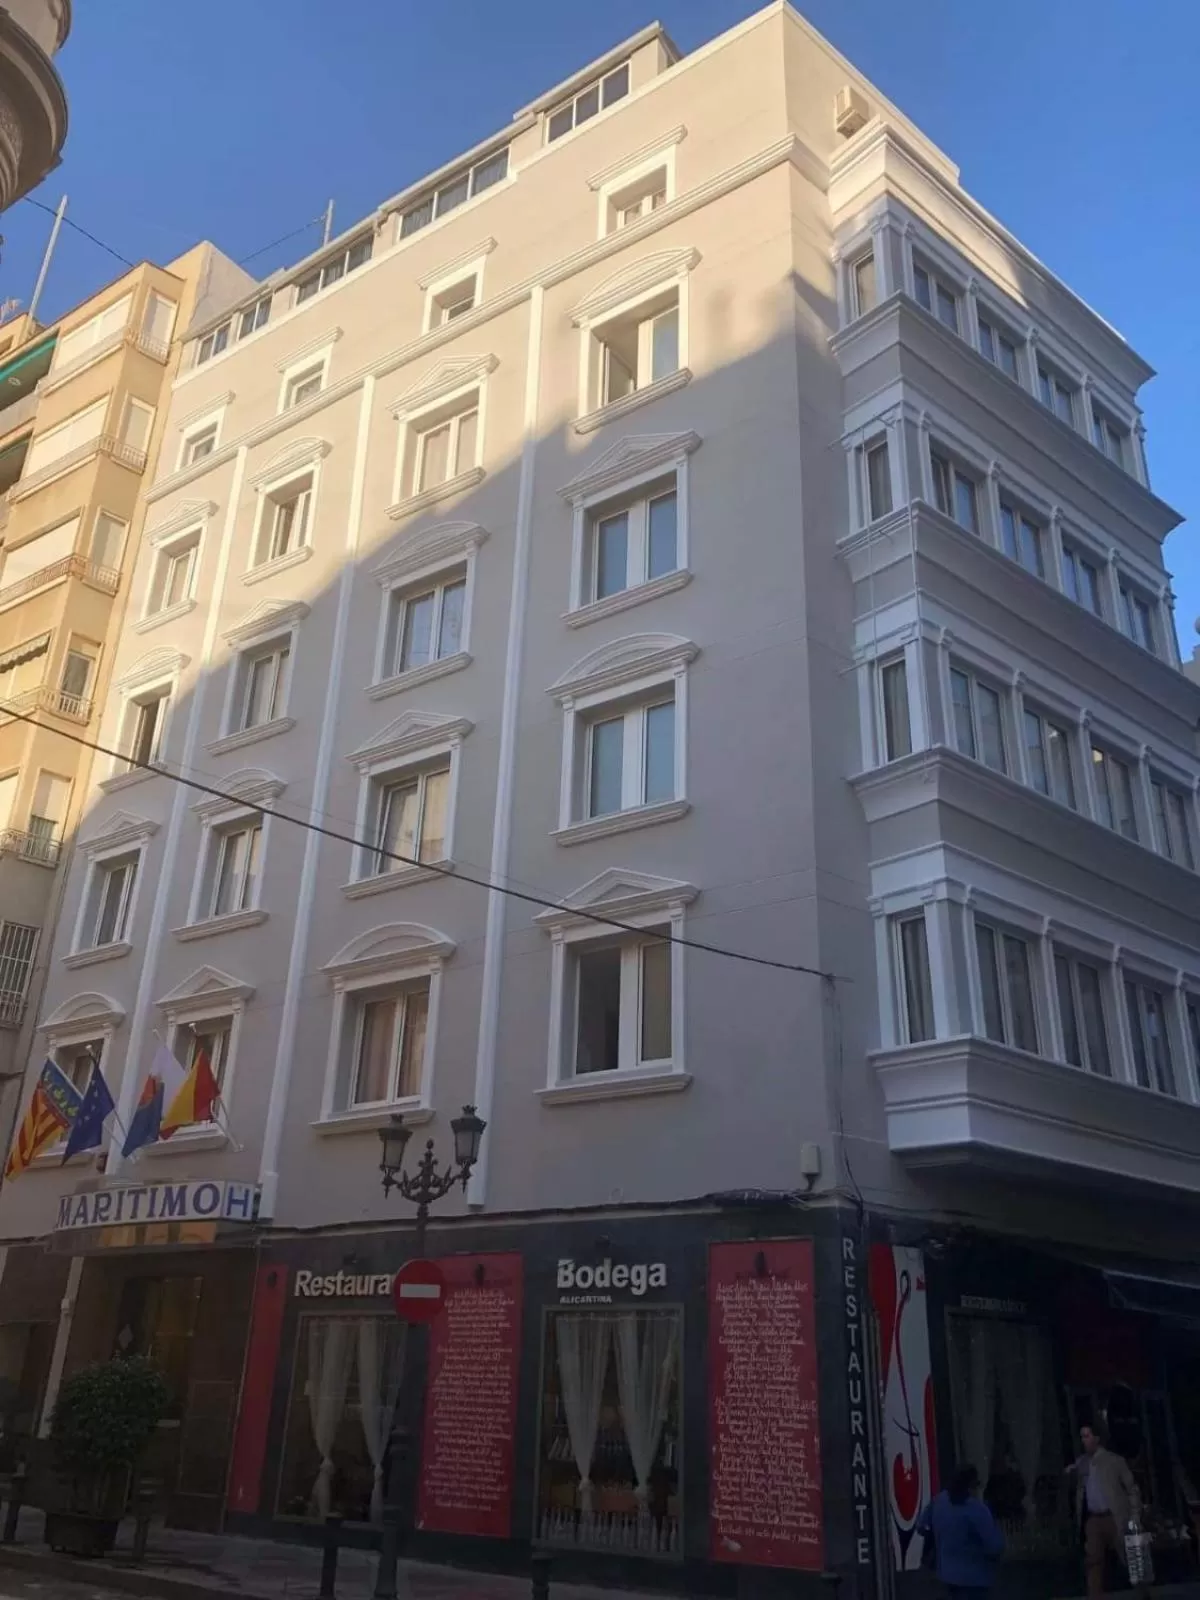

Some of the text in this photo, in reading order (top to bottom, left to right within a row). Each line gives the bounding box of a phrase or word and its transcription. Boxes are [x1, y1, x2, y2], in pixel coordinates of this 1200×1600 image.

[58, 1183, 220, 1228] MARITIMO
[226, 1187, 250, 1217] H
[294, 1270, 396, 1297] Restaura
[557, 1258, 667, 1295] Bodega
[842, 1237, 870, 1563] RESTAURANTE
